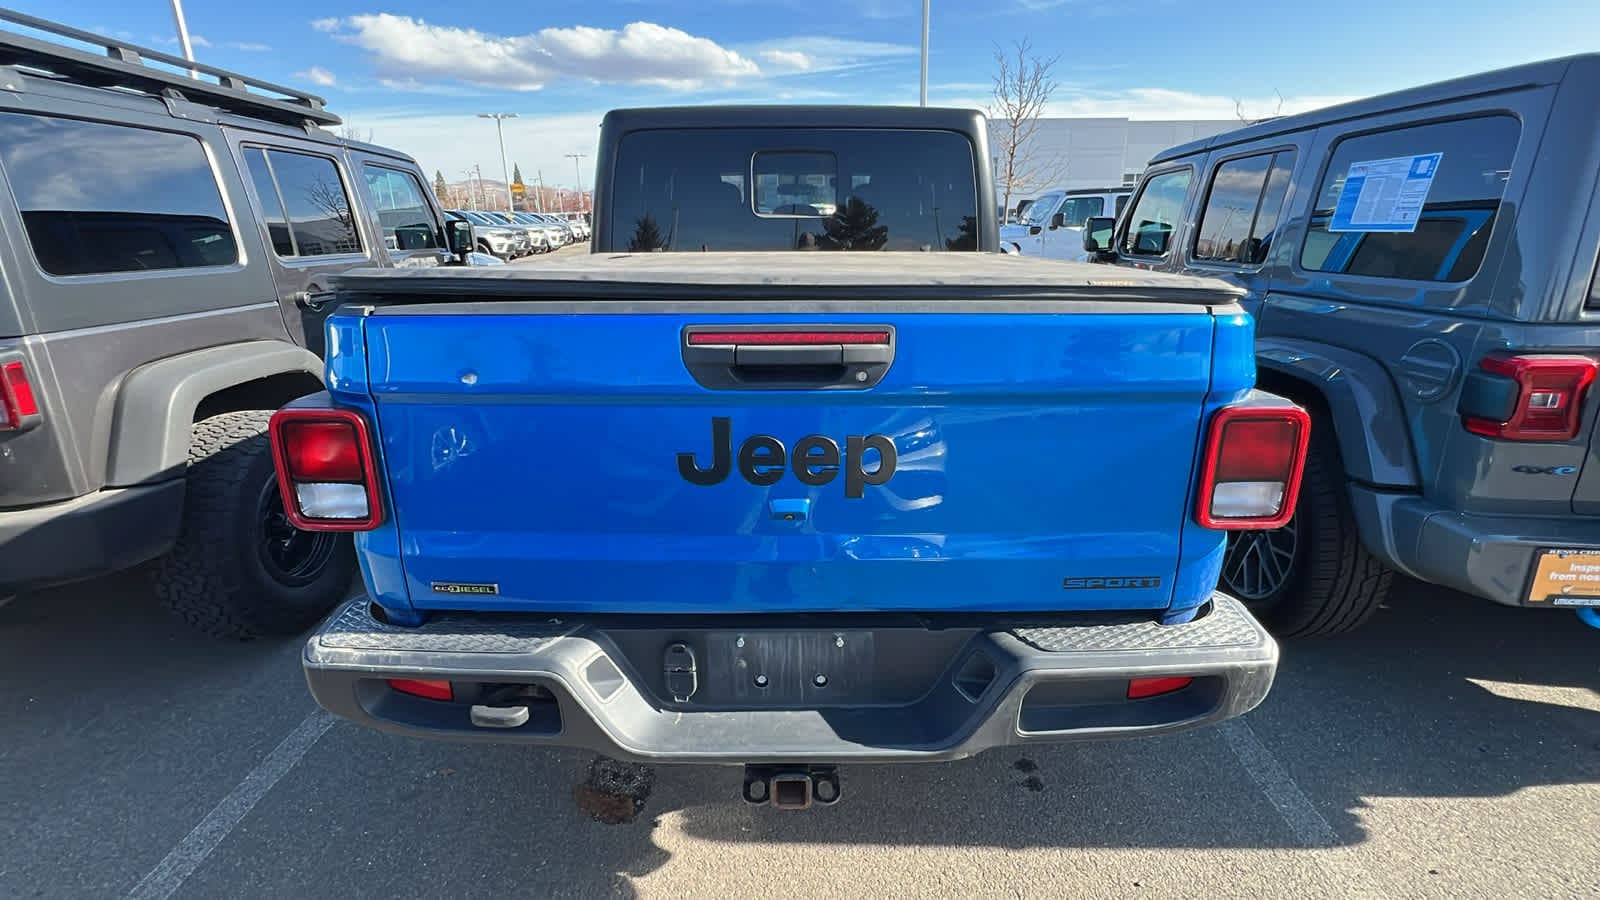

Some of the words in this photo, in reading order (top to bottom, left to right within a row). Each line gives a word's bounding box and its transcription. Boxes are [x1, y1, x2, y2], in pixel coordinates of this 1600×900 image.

[676, 416, 898, 499] Jeep
[1063, 576, 1161, 590] SPORT
[1549, 571, 1577, 582] from
